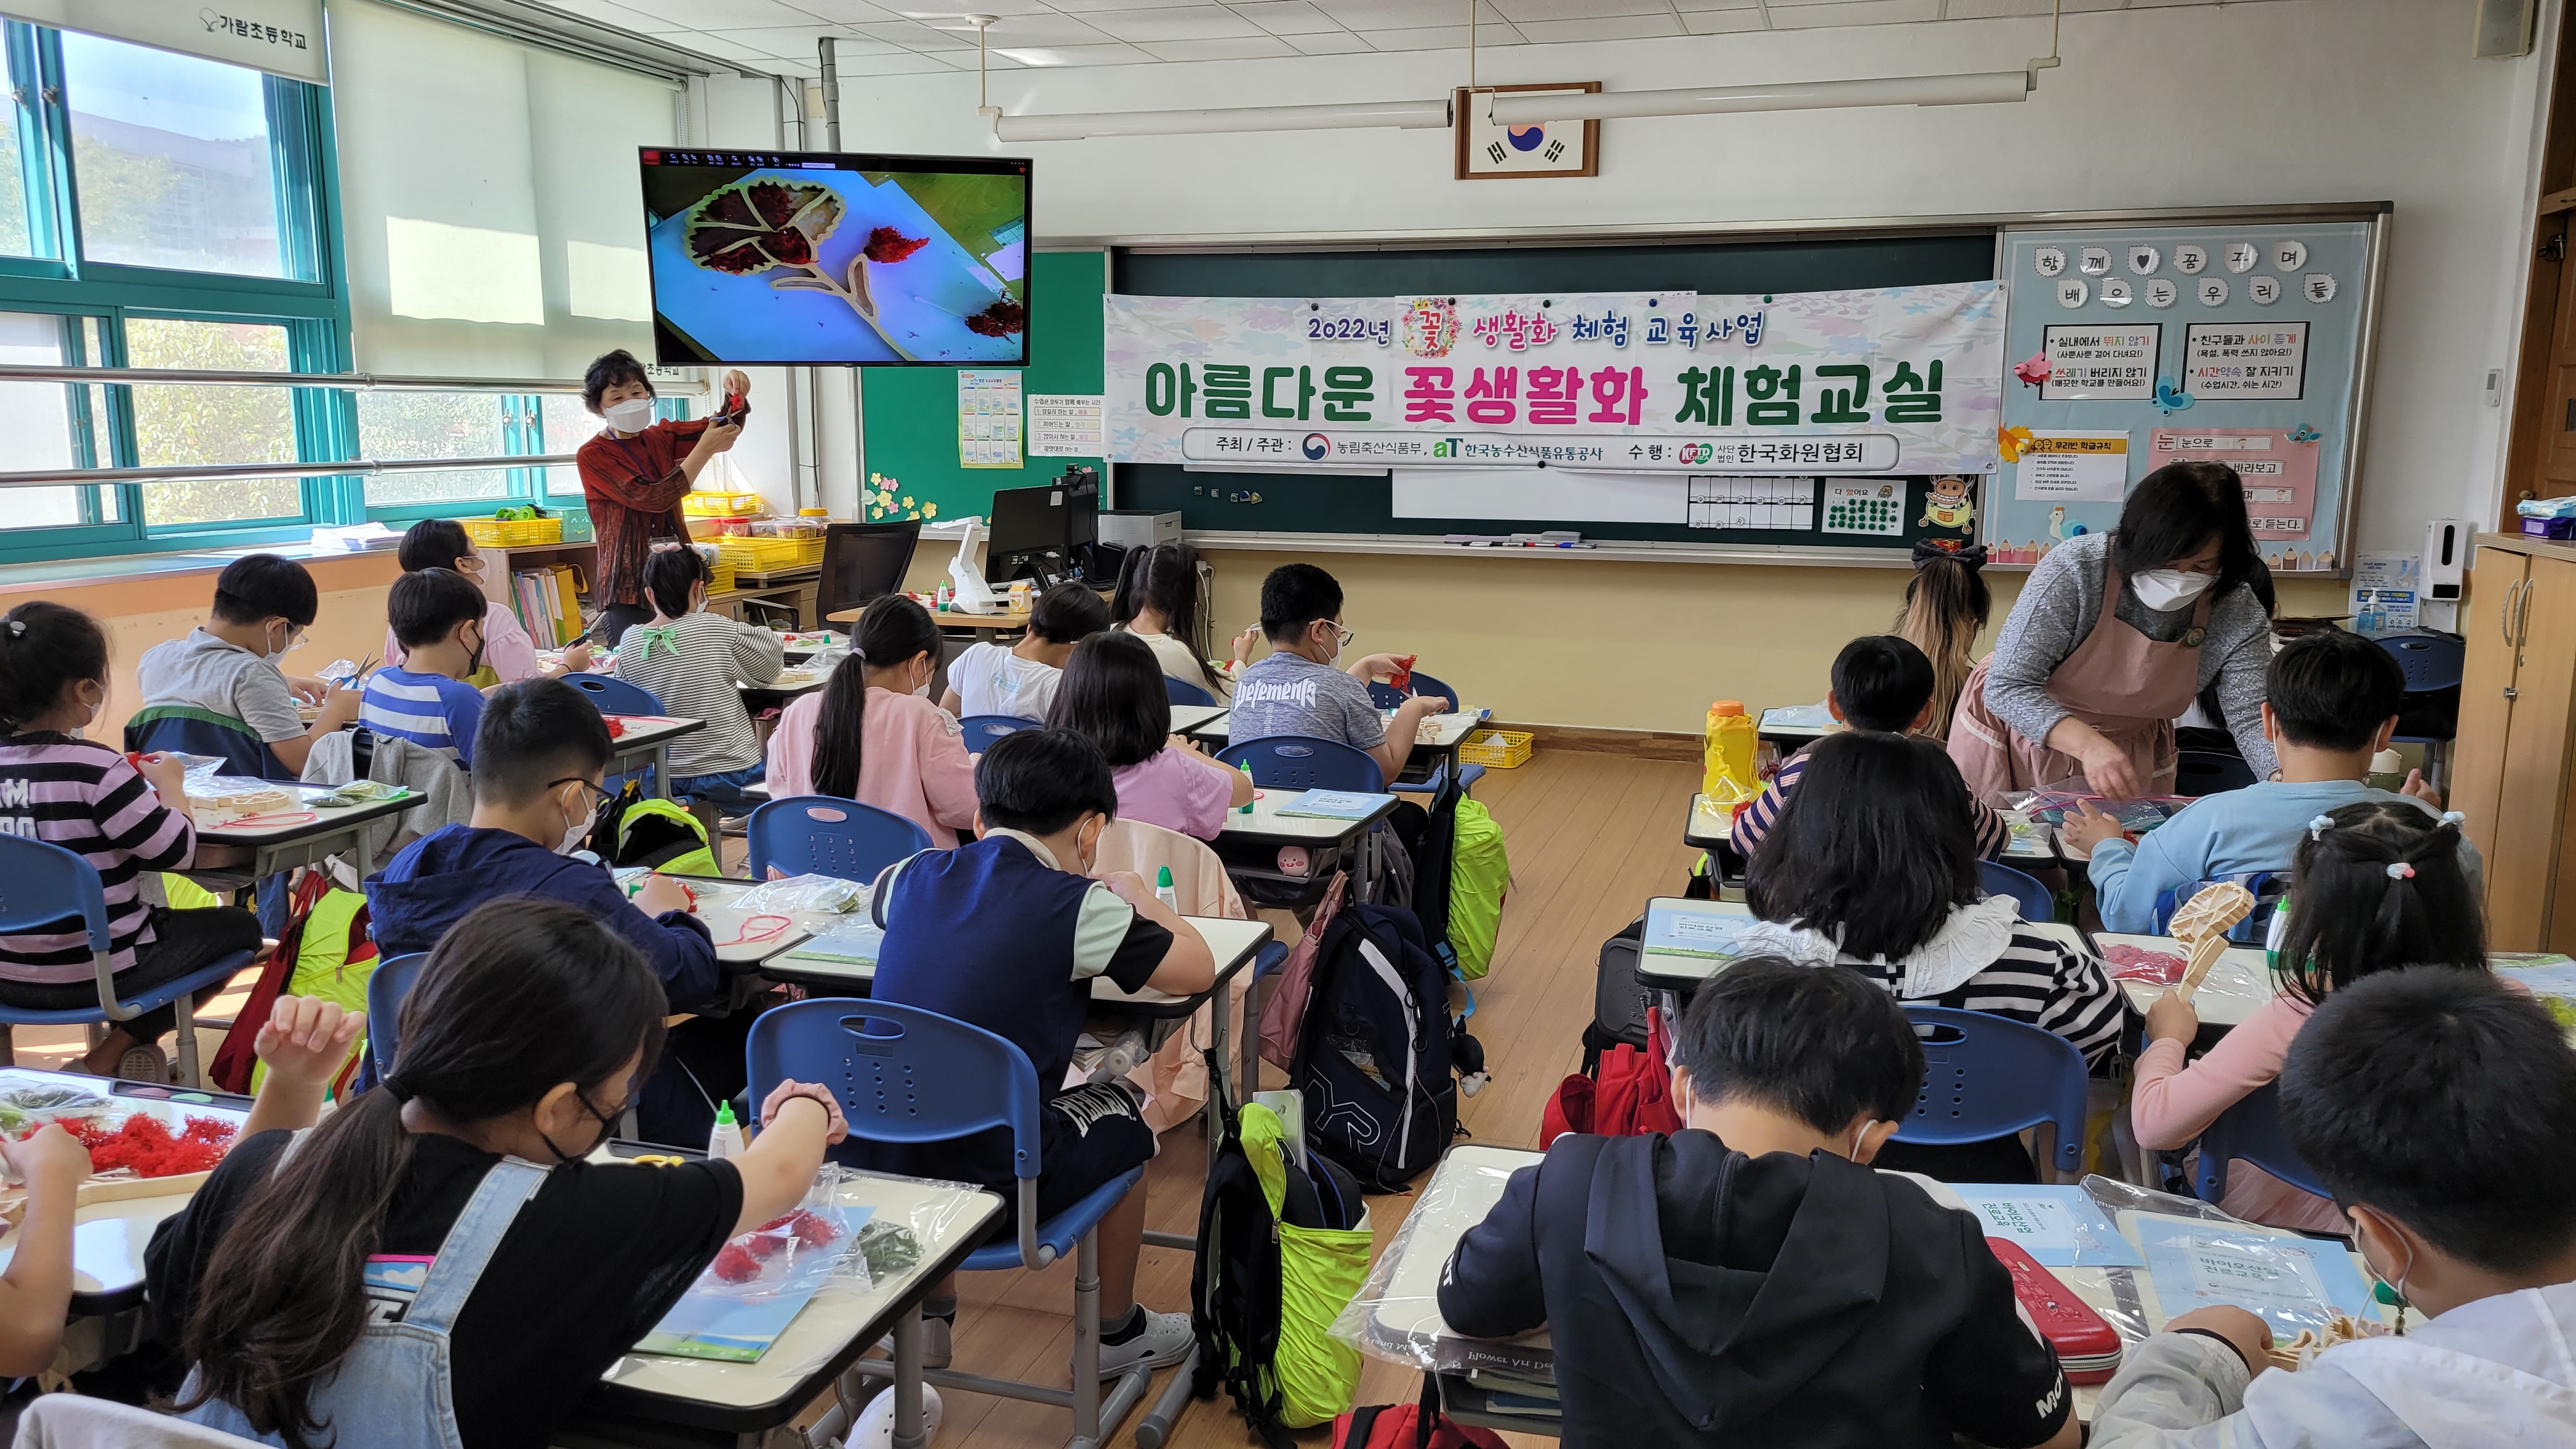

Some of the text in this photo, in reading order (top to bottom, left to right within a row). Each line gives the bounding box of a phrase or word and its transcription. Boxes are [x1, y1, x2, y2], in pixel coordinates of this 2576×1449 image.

[220, 15, 307, 50] 가람초등학교
[1308, 310, 1762, 349] 2022년 꽃 생활화 체험 교육사업
[2058, 335, 2150, 347] 실내에서 뛰지 않기
[2200, 334, 2297, 346] 친구들과 사이 좋게
[2057, 350, 2092, 358] (사뿐사뿐
[2196, 349, 2220, 358] (욕설,
[2221, 349, 2239, 357] 폭력
[2260, 348, 2292, 356] 않아요!)
[2055, 367, 2147, 378] 쓰레기 버리지 않기
[2197, 366, 2294, 378] 시간약속 잘 지키기
[2081, 379, 2105, 387] 학교를
[2108, 379, 2145, 387] 만들어요!)
[2242, 381, 2260, 389] 쉬는
[2262, 380, 2282, 389] 시간)
[1146, 360, 1943, 426] 아름다운 꽃생활화 체험교실
[1216, 437, 1242, 452] 주최
[1257, 437, 1284, 452] 주관
[1433, 438, 1464, 458] aT
[2055, 442, 2112, 450] 우리반 학급규칙
[2157, 434, 2174, 450] 눈
[2182, 438, 2213, 448] 눈으로
[1464, 443, 1604, 462] 한국농수산식품유통공사
[1717, 445, 1736, 453] 사단
[1738, 443, 1863, 463] 한국화원협회
[1717, 454, 1734, 463] 법인
[2234, 463, 2276, 473] 바라보고
[2266, 519, 2300, 529] 듣는다.
[1982, 1202, 2011, 1227] 진로교육
[2002, 1202, 2034, 1234] 바이오산업
